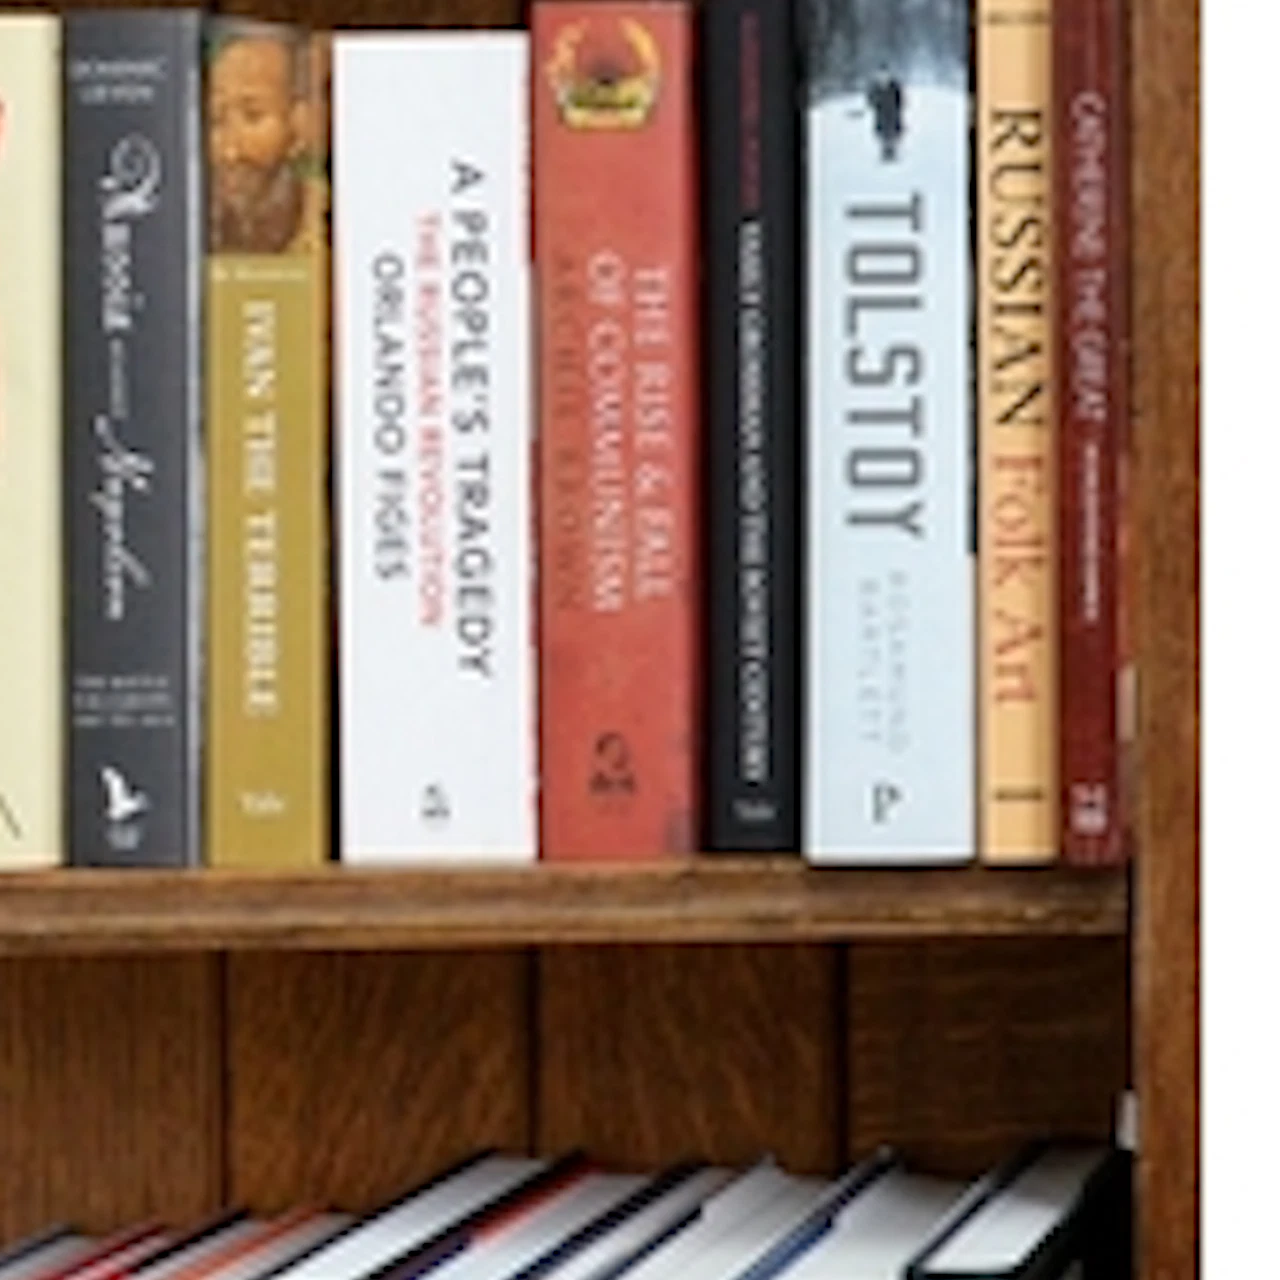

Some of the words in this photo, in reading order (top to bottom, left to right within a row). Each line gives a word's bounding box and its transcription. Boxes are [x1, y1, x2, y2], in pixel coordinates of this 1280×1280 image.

[450, 161, 487, 196] A
[415, 210, 444, 270] THE
[588, 252, 624, 305] OF
[991, 108, 1046, 429] RUSSIAN
[242, 301, 278, 399] IVAN
[416, 282, 444, 417] RUSSIAN
[450, 209, 490, 434] PEOPLE'S
[634, 267, 672, 350] THE
[1071, 269, 1108, 326] THE
[372, 252, 407, 458] ORLANDO
[634, 361, 672, 450] RISE
[844, 191, 924, 540] TOLSTOY
[1071, 330, 1108, 420] GREAT
[242, 411, 278, 498] THE
[587, 323, 625, 611] COMMUNISM
[88, 414, 156, 620] Napoleon
[374, 470, 410, 582] FIGES
[418, 425, 446, 627] REVOLUTION
[455, 453, 495, 679] TRAGEDY
[634, 507, 672, 601] FALL
[995, 453, 1046, 587] Folk
[242, 510, 278, 719] TERRIBLE
[993, 608, 1045, 709] Art
